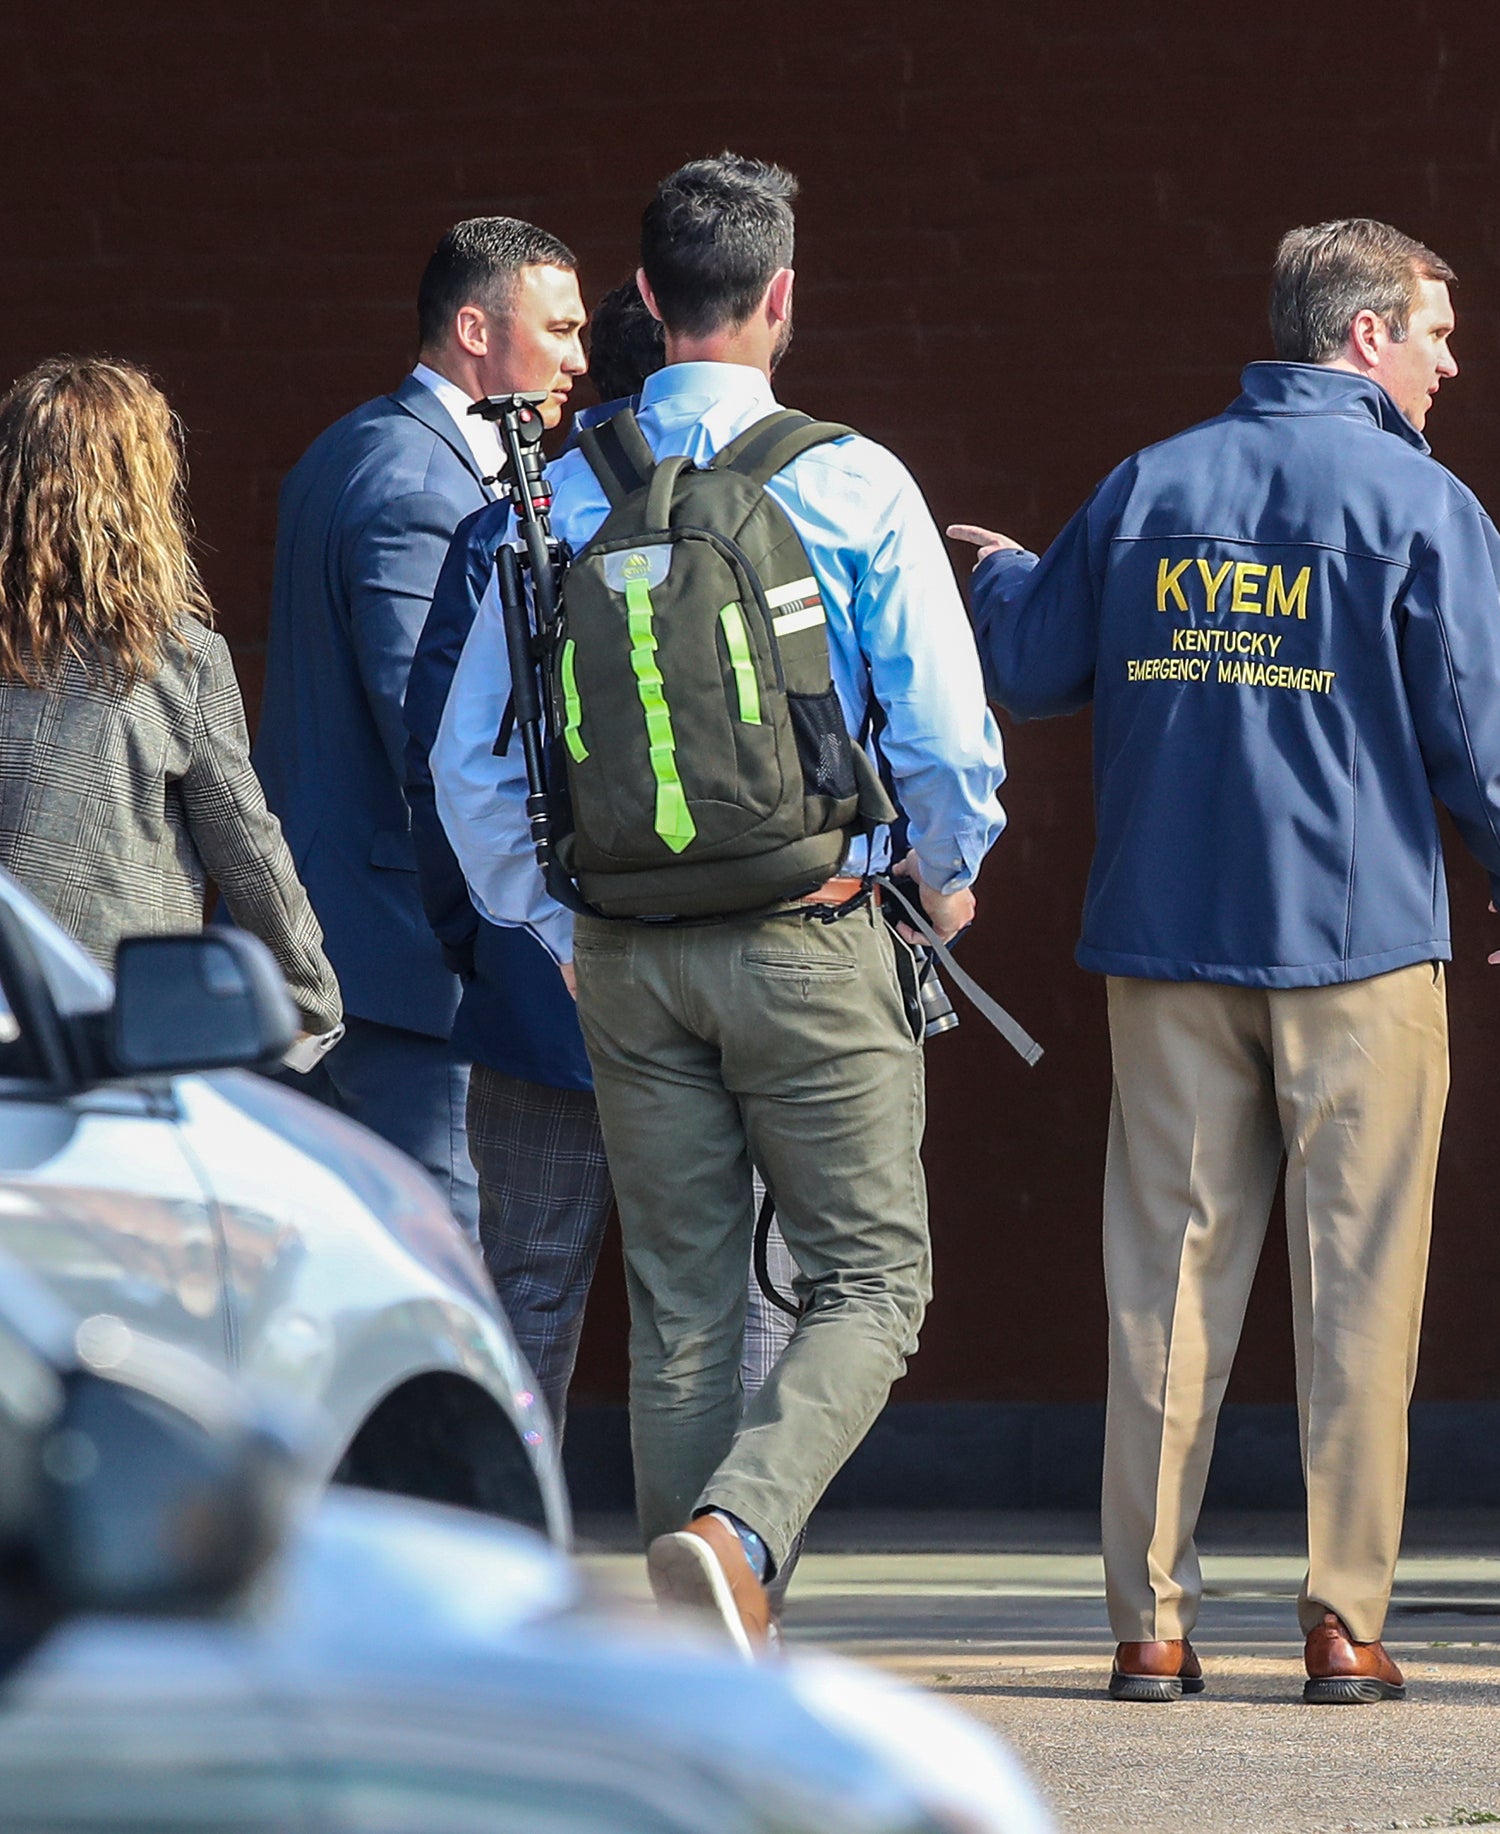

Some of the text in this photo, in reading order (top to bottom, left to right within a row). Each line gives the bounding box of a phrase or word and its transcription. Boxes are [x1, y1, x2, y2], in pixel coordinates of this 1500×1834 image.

[1156, 558, 1312, 620] KYEM
[1172, 628, 1283, 658] KENTUCKY
[1127, 658, 1336, 694] EMERGENCY MANAGEMENT
